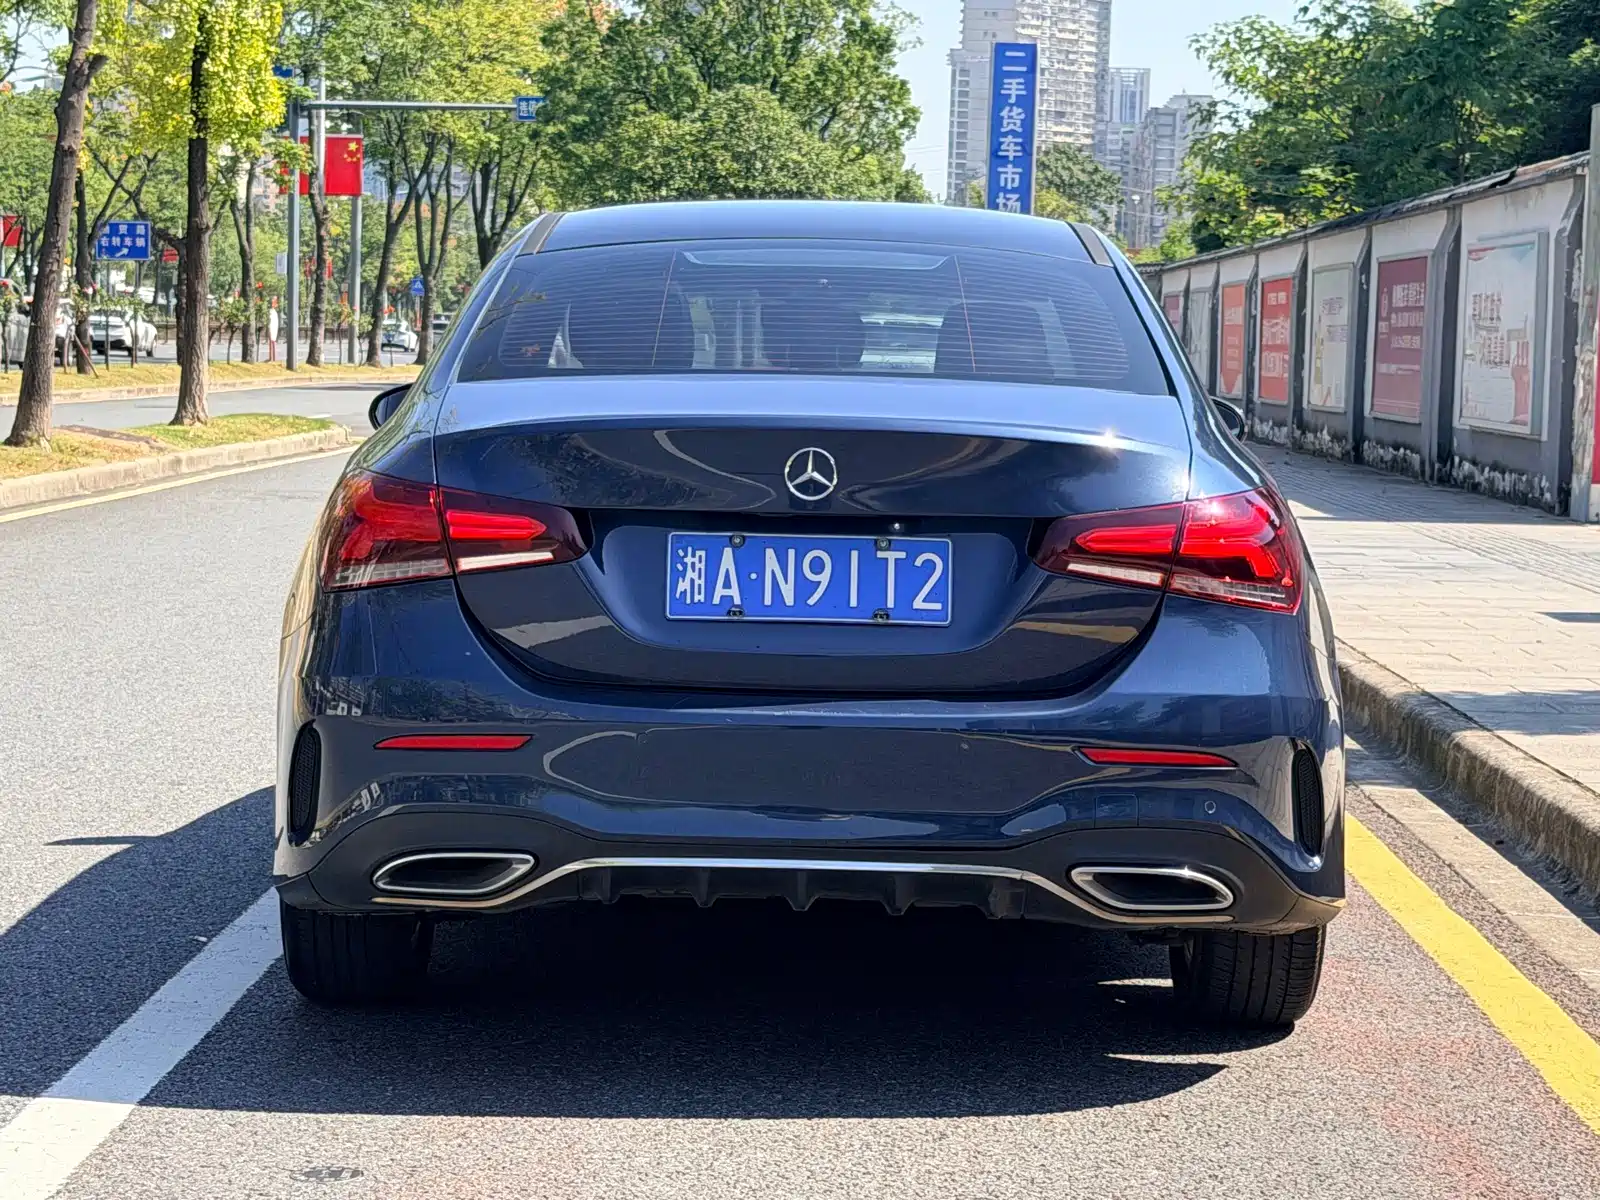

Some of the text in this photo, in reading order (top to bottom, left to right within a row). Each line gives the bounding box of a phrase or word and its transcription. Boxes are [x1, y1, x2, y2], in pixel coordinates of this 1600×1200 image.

[996, 51, 1027, 213] 二手货车市场
[101, 236, 146, 248] 右转车辆
[675, 546, 944, 611] 湘A·N91T2
